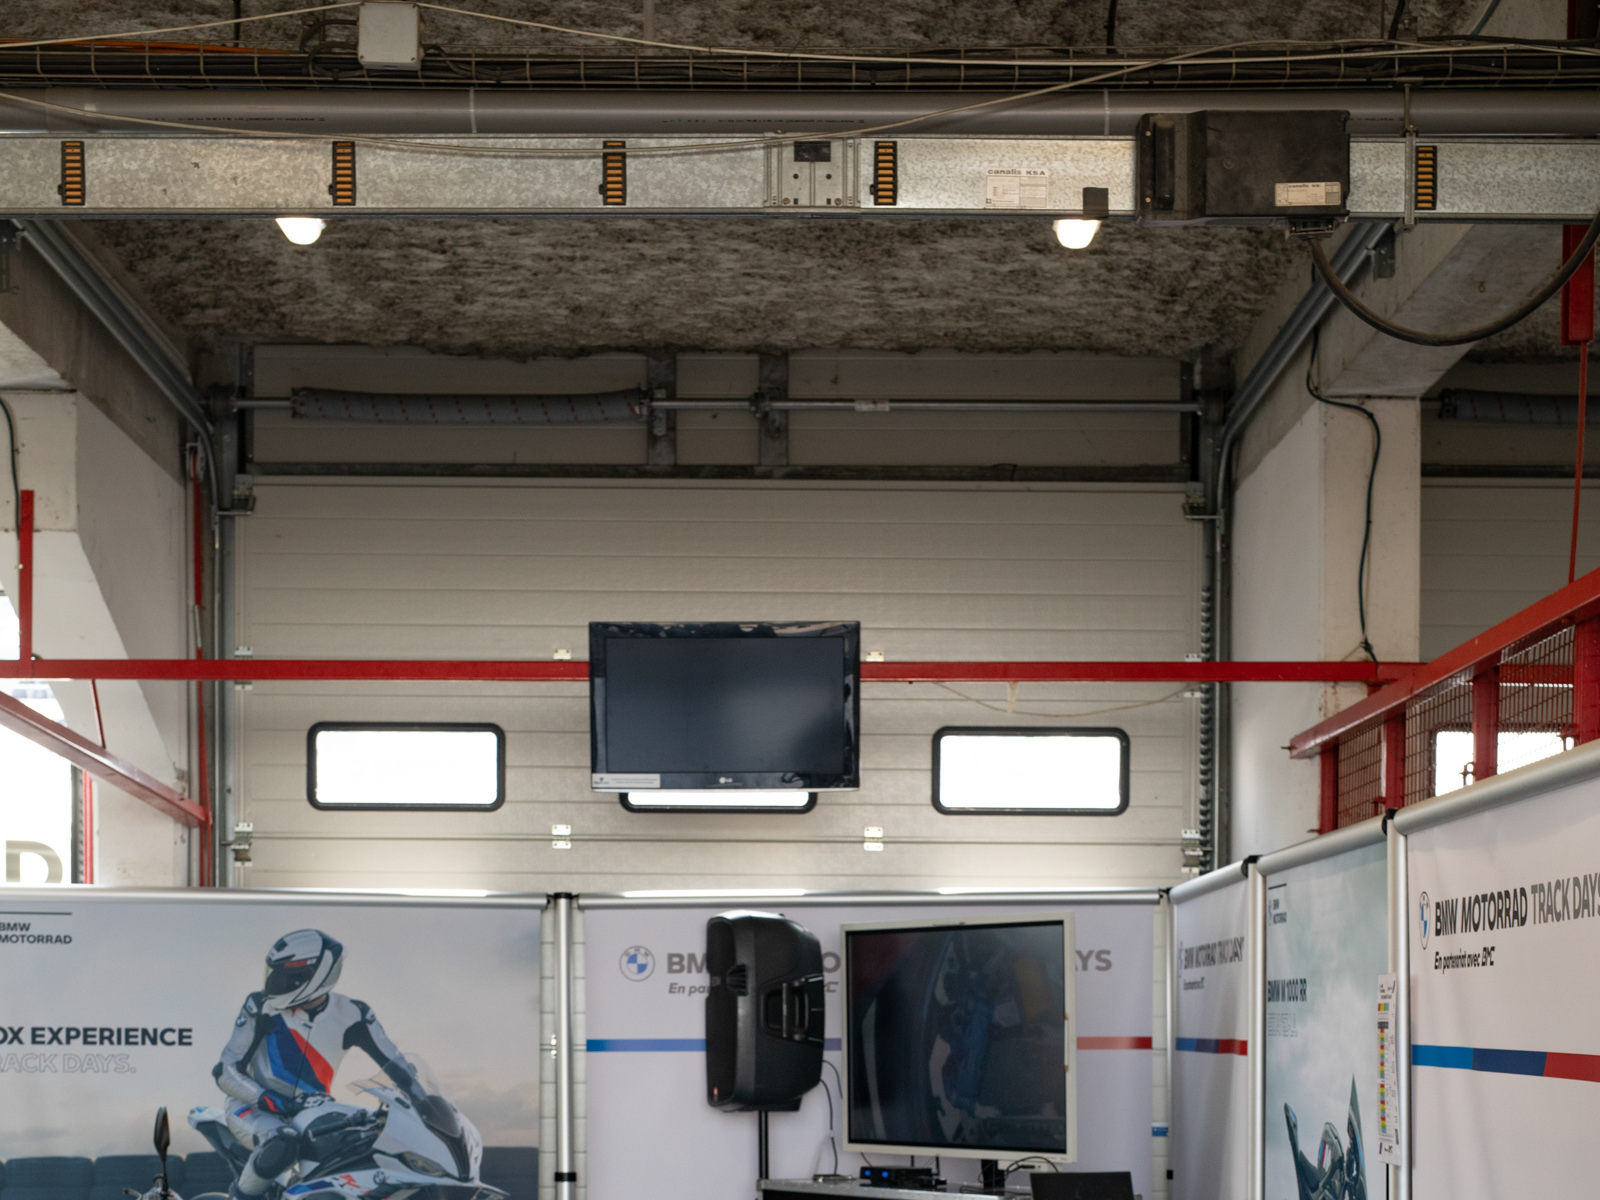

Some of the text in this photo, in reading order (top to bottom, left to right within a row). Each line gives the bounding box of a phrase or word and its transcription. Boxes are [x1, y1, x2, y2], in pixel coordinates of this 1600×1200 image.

[1435, 898, 1458, 937] BMW
[1461, 887, 1528, 934] MOTORRAD
[1531, 877, 1571, 925] TRACK
[31, 1027, 193, 1046] EXPERIENCE
[62, 1053, 137, 1073] DAYS.
